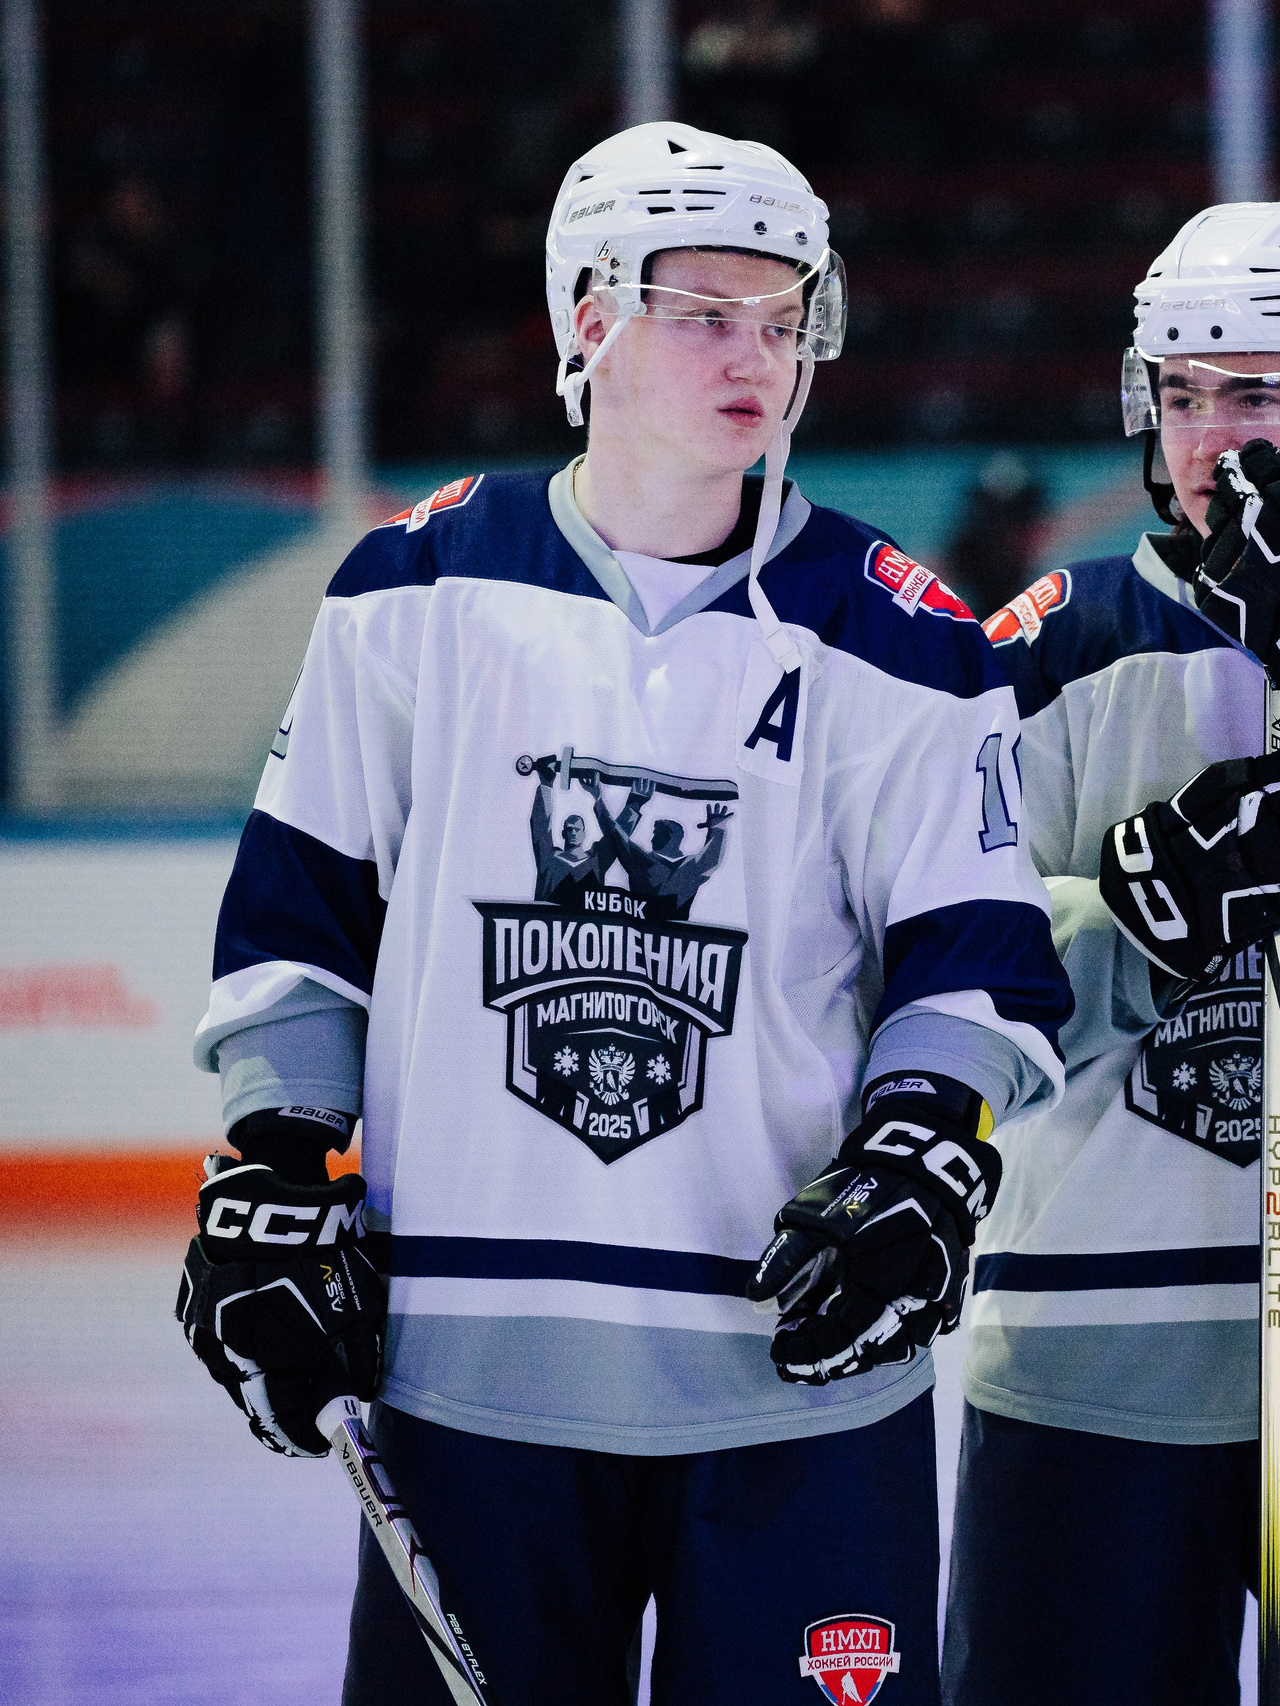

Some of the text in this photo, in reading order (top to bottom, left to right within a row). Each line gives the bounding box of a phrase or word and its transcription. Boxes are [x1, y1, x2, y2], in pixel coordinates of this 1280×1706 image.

[568, 199, 616, 224] BAUER
[744, 666, 801, 763] A
[975, 732, 1023, 854] 1
[584, 890, 647, 920] КУБОК
[1114, 817, 1189, 942] CC
[494, 918, 734, 1012] ПОКОЛЕНИЯ
[536, 991, 679, 1045] МАГНИТОГОРСК
[289, 1106, 344, 1128] BAUER
[588, 1112, 632, 1140] 2025
[863, 1120, 988, 1219] CCM
[206, 1197, 366, 1246] CCM
[346, 1461, 383, 1528] BAUER
[446, 1613, 463, 1635] P28
[461, 1643, 474, 1657] 87
[468, 1658, 488, 1685] FLEX
[807, 1655, 893, 1670] ХОККЕЙ РОССИИ
[821, 1628, 880, 1652] НМХЛ
